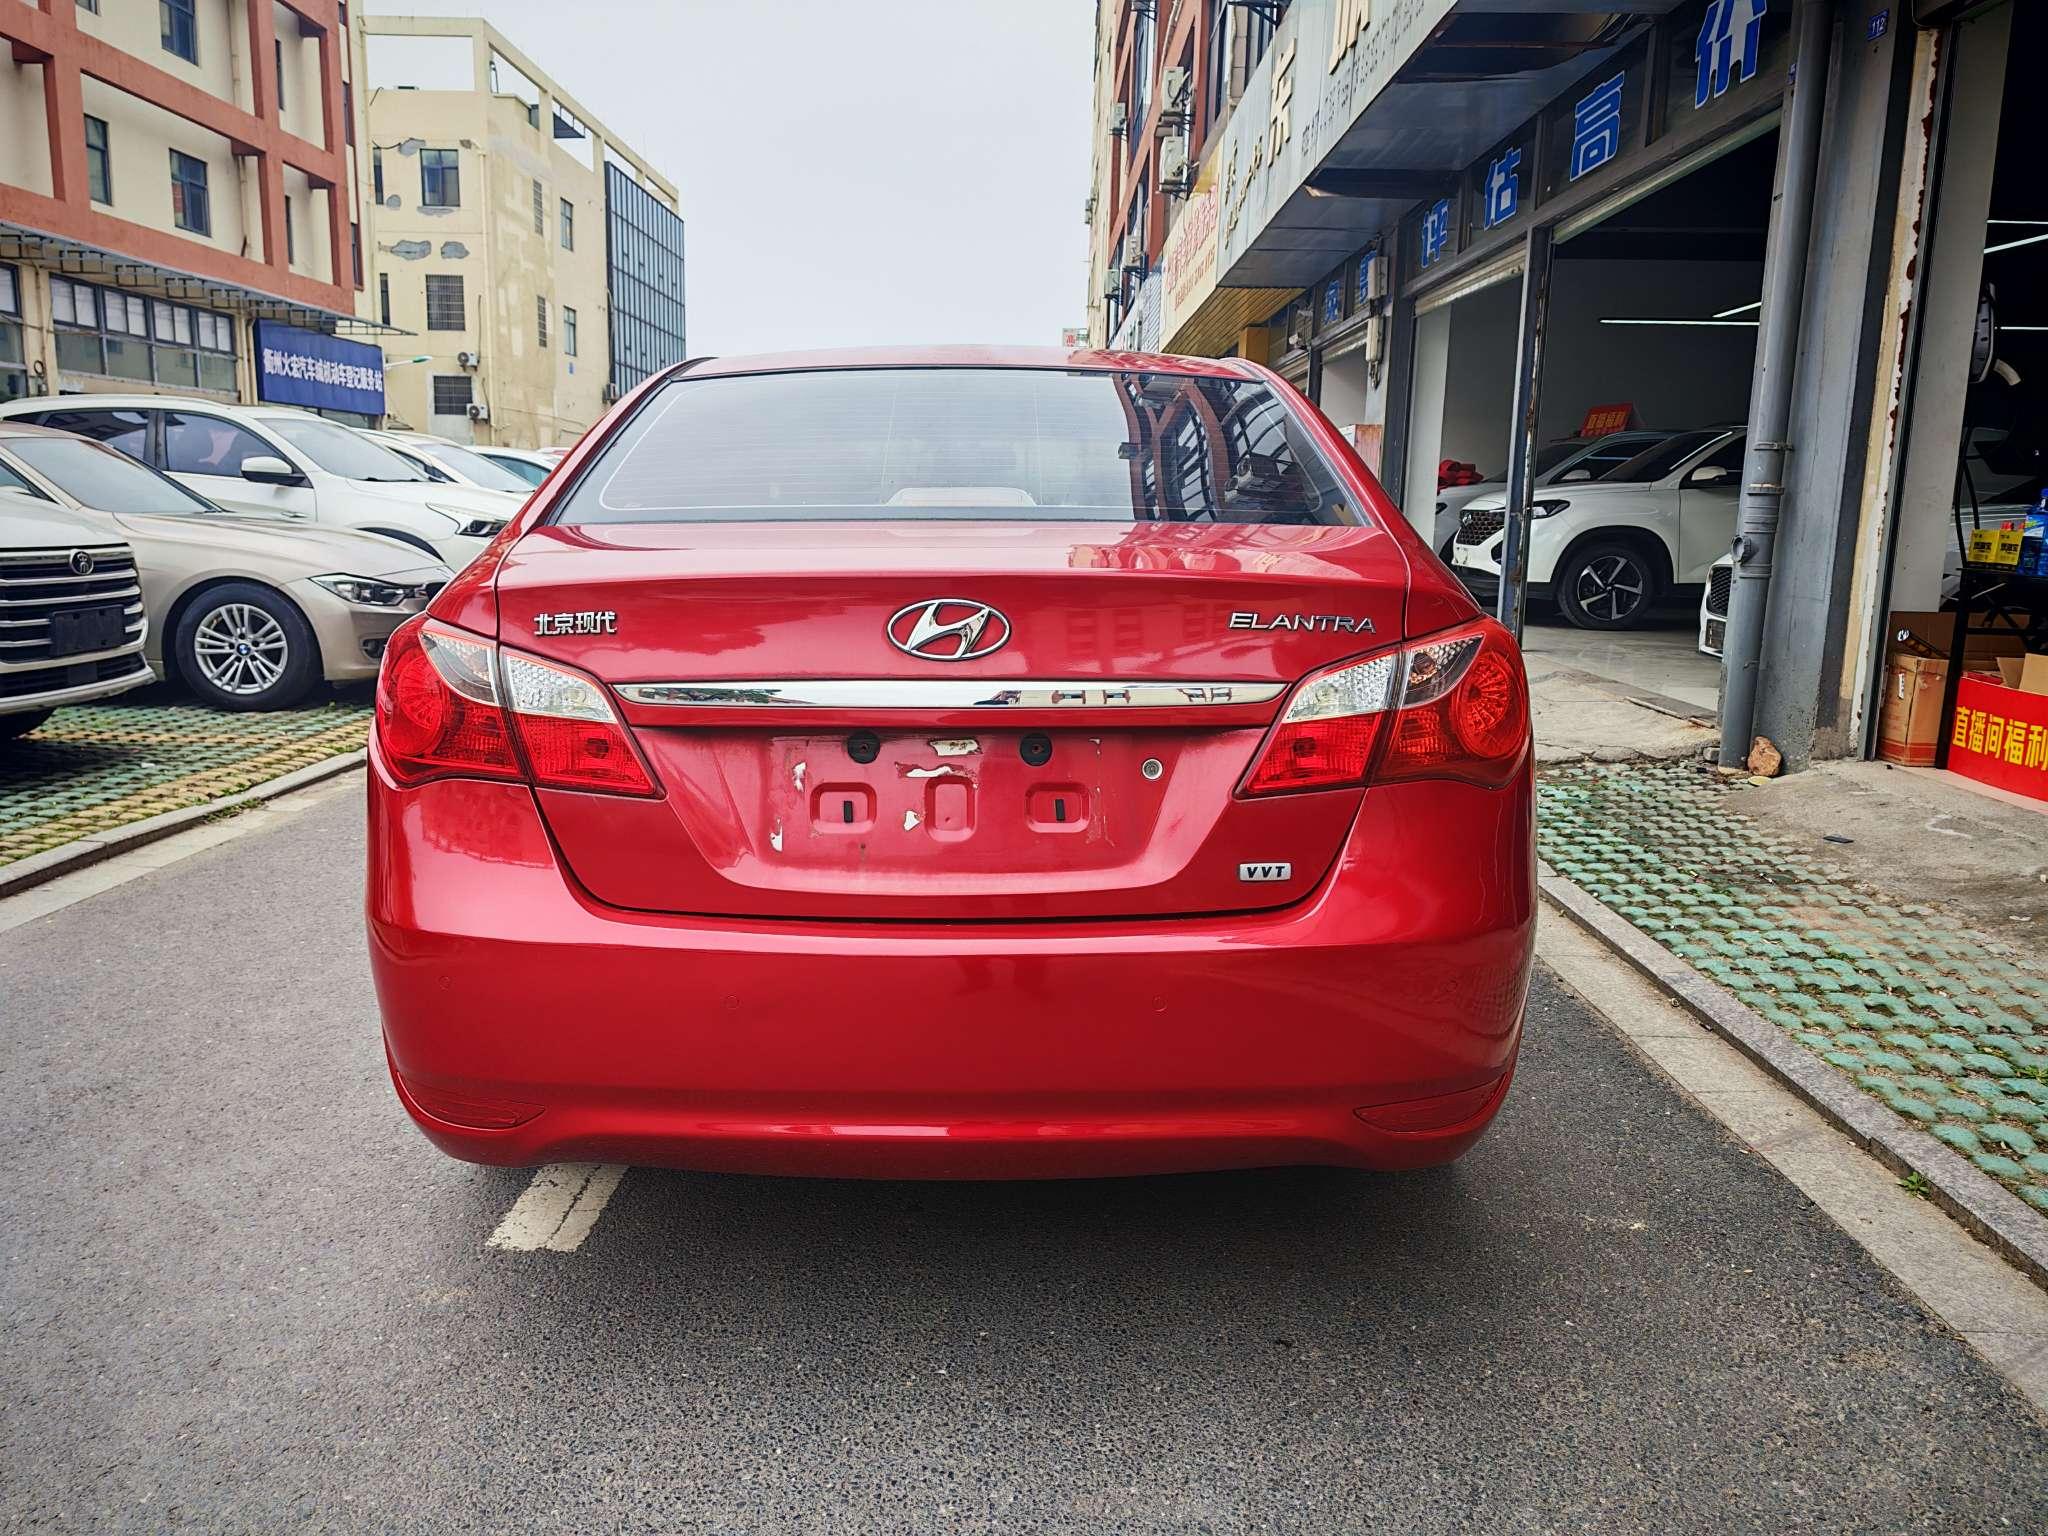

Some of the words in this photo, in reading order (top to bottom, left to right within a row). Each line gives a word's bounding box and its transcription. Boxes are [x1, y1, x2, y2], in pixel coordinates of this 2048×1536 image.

[534, 611, 618, 635] 北京现代
[1229, 612, 1377, 634] ELANTRA
[1952, 705, 2048, 771] 直播间福利
[1246, 865, 1286, 879] VVT
